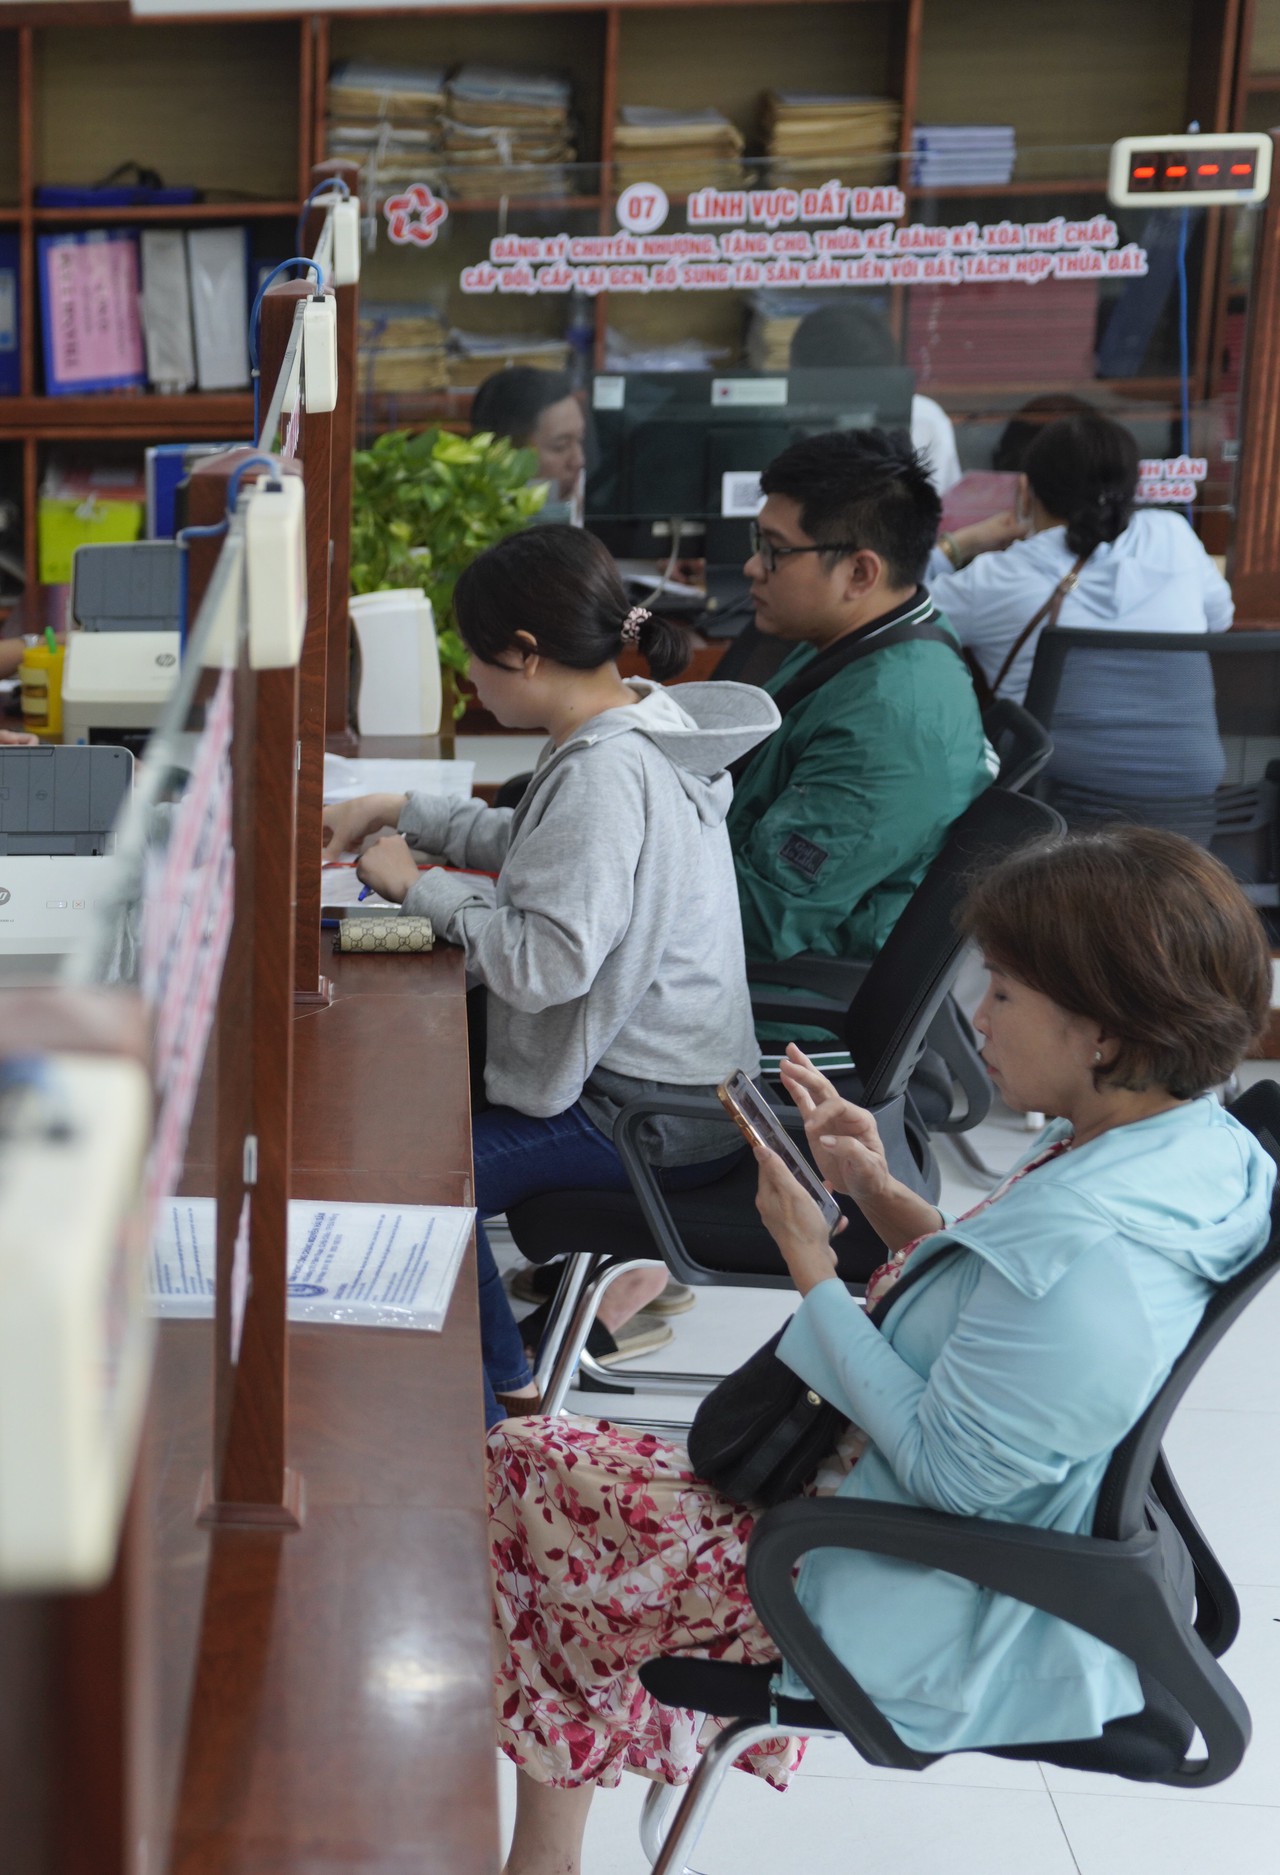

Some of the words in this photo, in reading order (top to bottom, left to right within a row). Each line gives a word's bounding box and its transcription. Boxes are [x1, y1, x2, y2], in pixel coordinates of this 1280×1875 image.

[627, 195, 658, 220] 07
[691, 187, 745, 220] LĨNH
[752, 188, 797, 221] VỰC
[802, 181, 848, 215] ĐẤT
